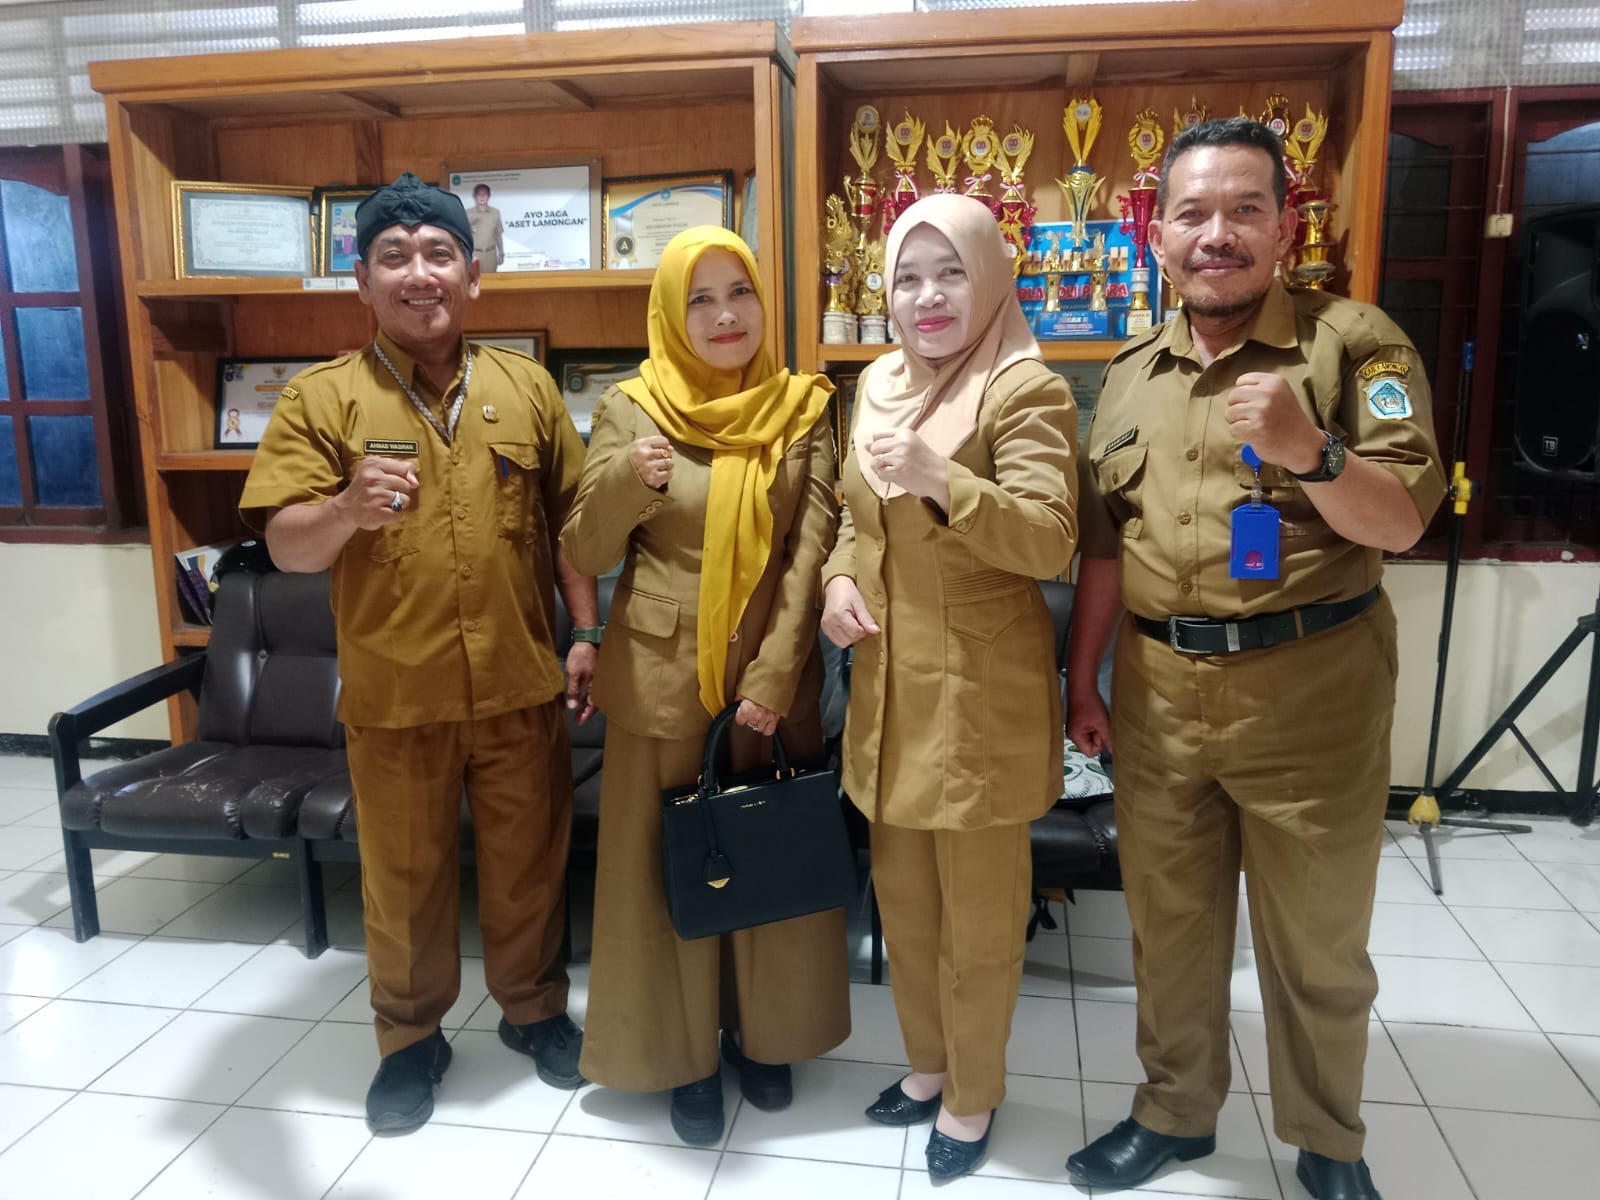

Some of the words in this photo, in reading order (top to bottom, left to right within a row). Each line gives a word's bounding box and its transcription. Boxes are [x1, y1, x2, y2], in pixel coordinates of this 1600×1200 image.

[523, 211, 543, 219] AYO
[544, 209, 568, 218] JAGA
[505, 219, 532, 228] "ASET
[533, 218, 588, 228] LAMONGAN"
[620, 240, 629, 250] A
[1018, 287, 1046, 301] OLA
